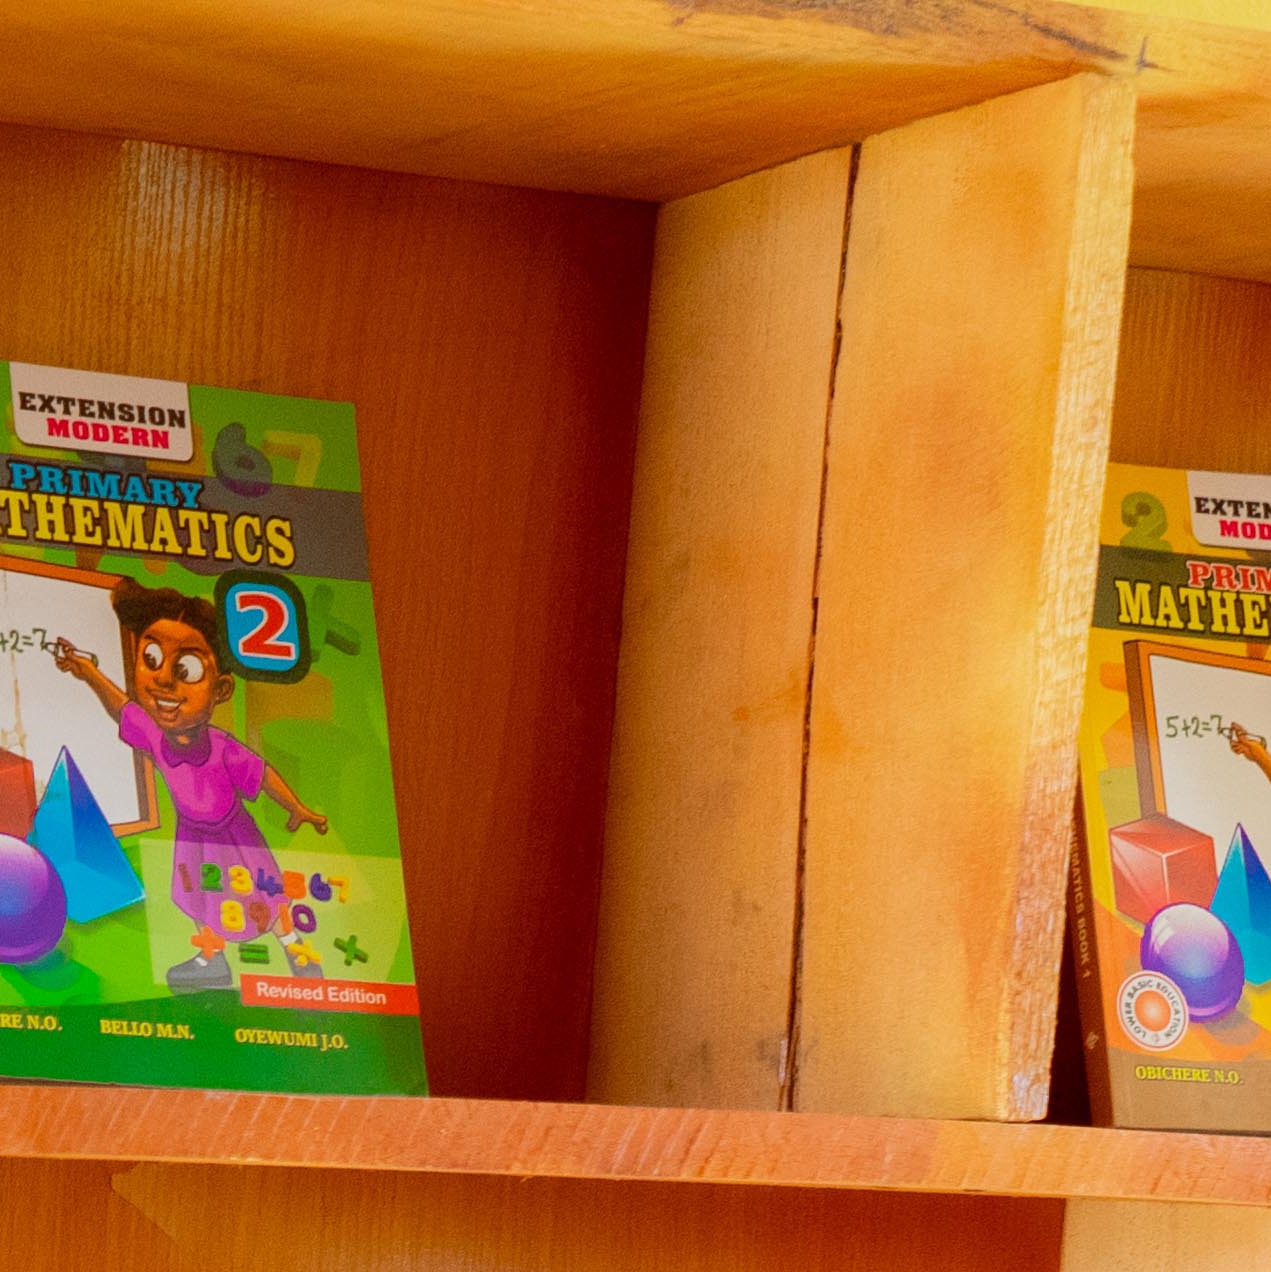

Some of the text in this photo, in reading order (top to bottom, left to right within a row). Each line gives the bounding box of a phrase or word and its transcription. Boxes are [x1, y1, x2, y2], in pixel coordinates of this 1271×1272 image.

[19, 391, 186, 429] EXTENSION
[47, 417, 170, 449] MODERN
[9, 462, 203, 509] PRIMARY
[235, 592, 295, 660] 2
[256, 981, 387, 1006] Revised Edition
[27, 1014, 63, 1032] N.O.
[100, 1020, 195, 1040] BELLO M.N.
[235, 1028, 349, 1052] OYEWUMI J.O.
